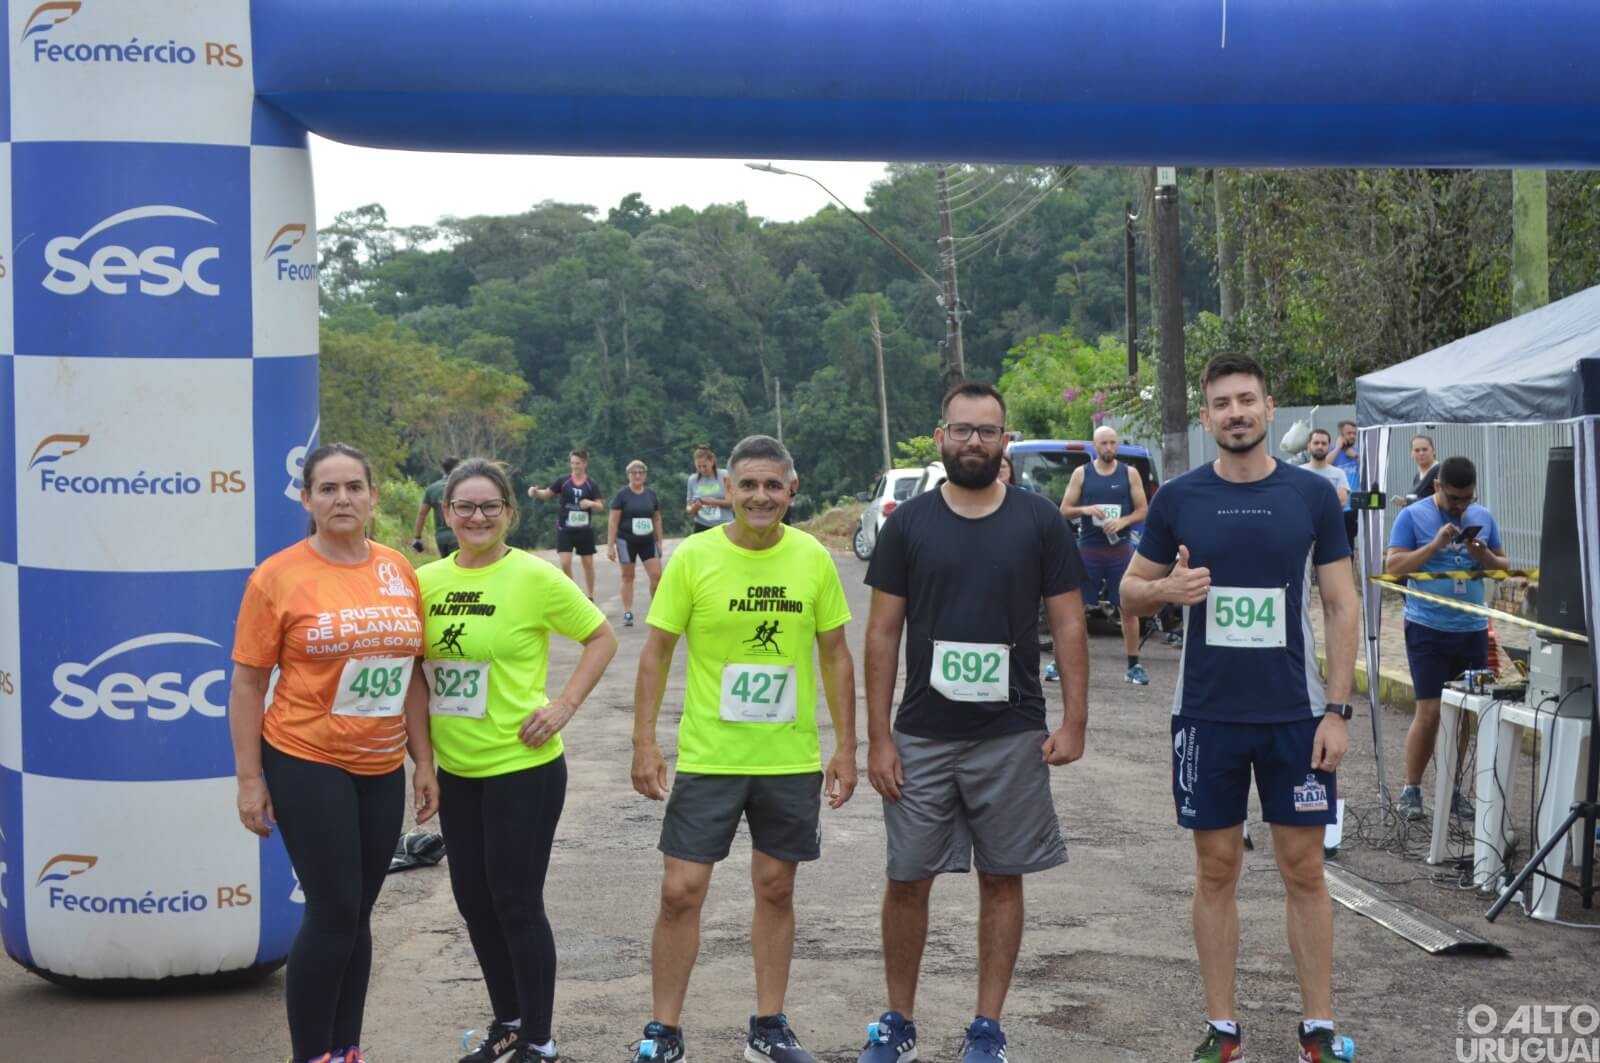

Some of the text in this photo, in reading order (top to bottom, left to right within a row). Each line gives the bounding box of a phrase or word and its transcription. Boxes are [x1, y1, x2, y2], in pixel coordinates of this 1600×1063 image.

[33, 38, 244, 68] Fecomércio RS
[40, 470, 246, 495] Fecomércio RS
[445, 591, 484, 603] CORRE
[747, 586, 787, 599] CORRE
[429, 603, 496, 616] PALMITINHO
[728, 598, 803, 614] PALMITINHO
[1215, 596, 1276, 628] 594
[306, 619, 421, 641] DE PLANALT
[305, 641, 350, 655] RUMO
[352, 636, 380, 649] AOS
[383, 636, 403, 647] 60
[941, 650, 1001, 683] 692
[349, 665, 404, 699] 493
[434, 666, 480, 698] 623
[730, 671, 789, 704] 427
[1295, 790, 1327, 802] RAJA
[49, 884, 253, 914] Fecomércio RS
[492, 1031, 518, 1055] FILA
